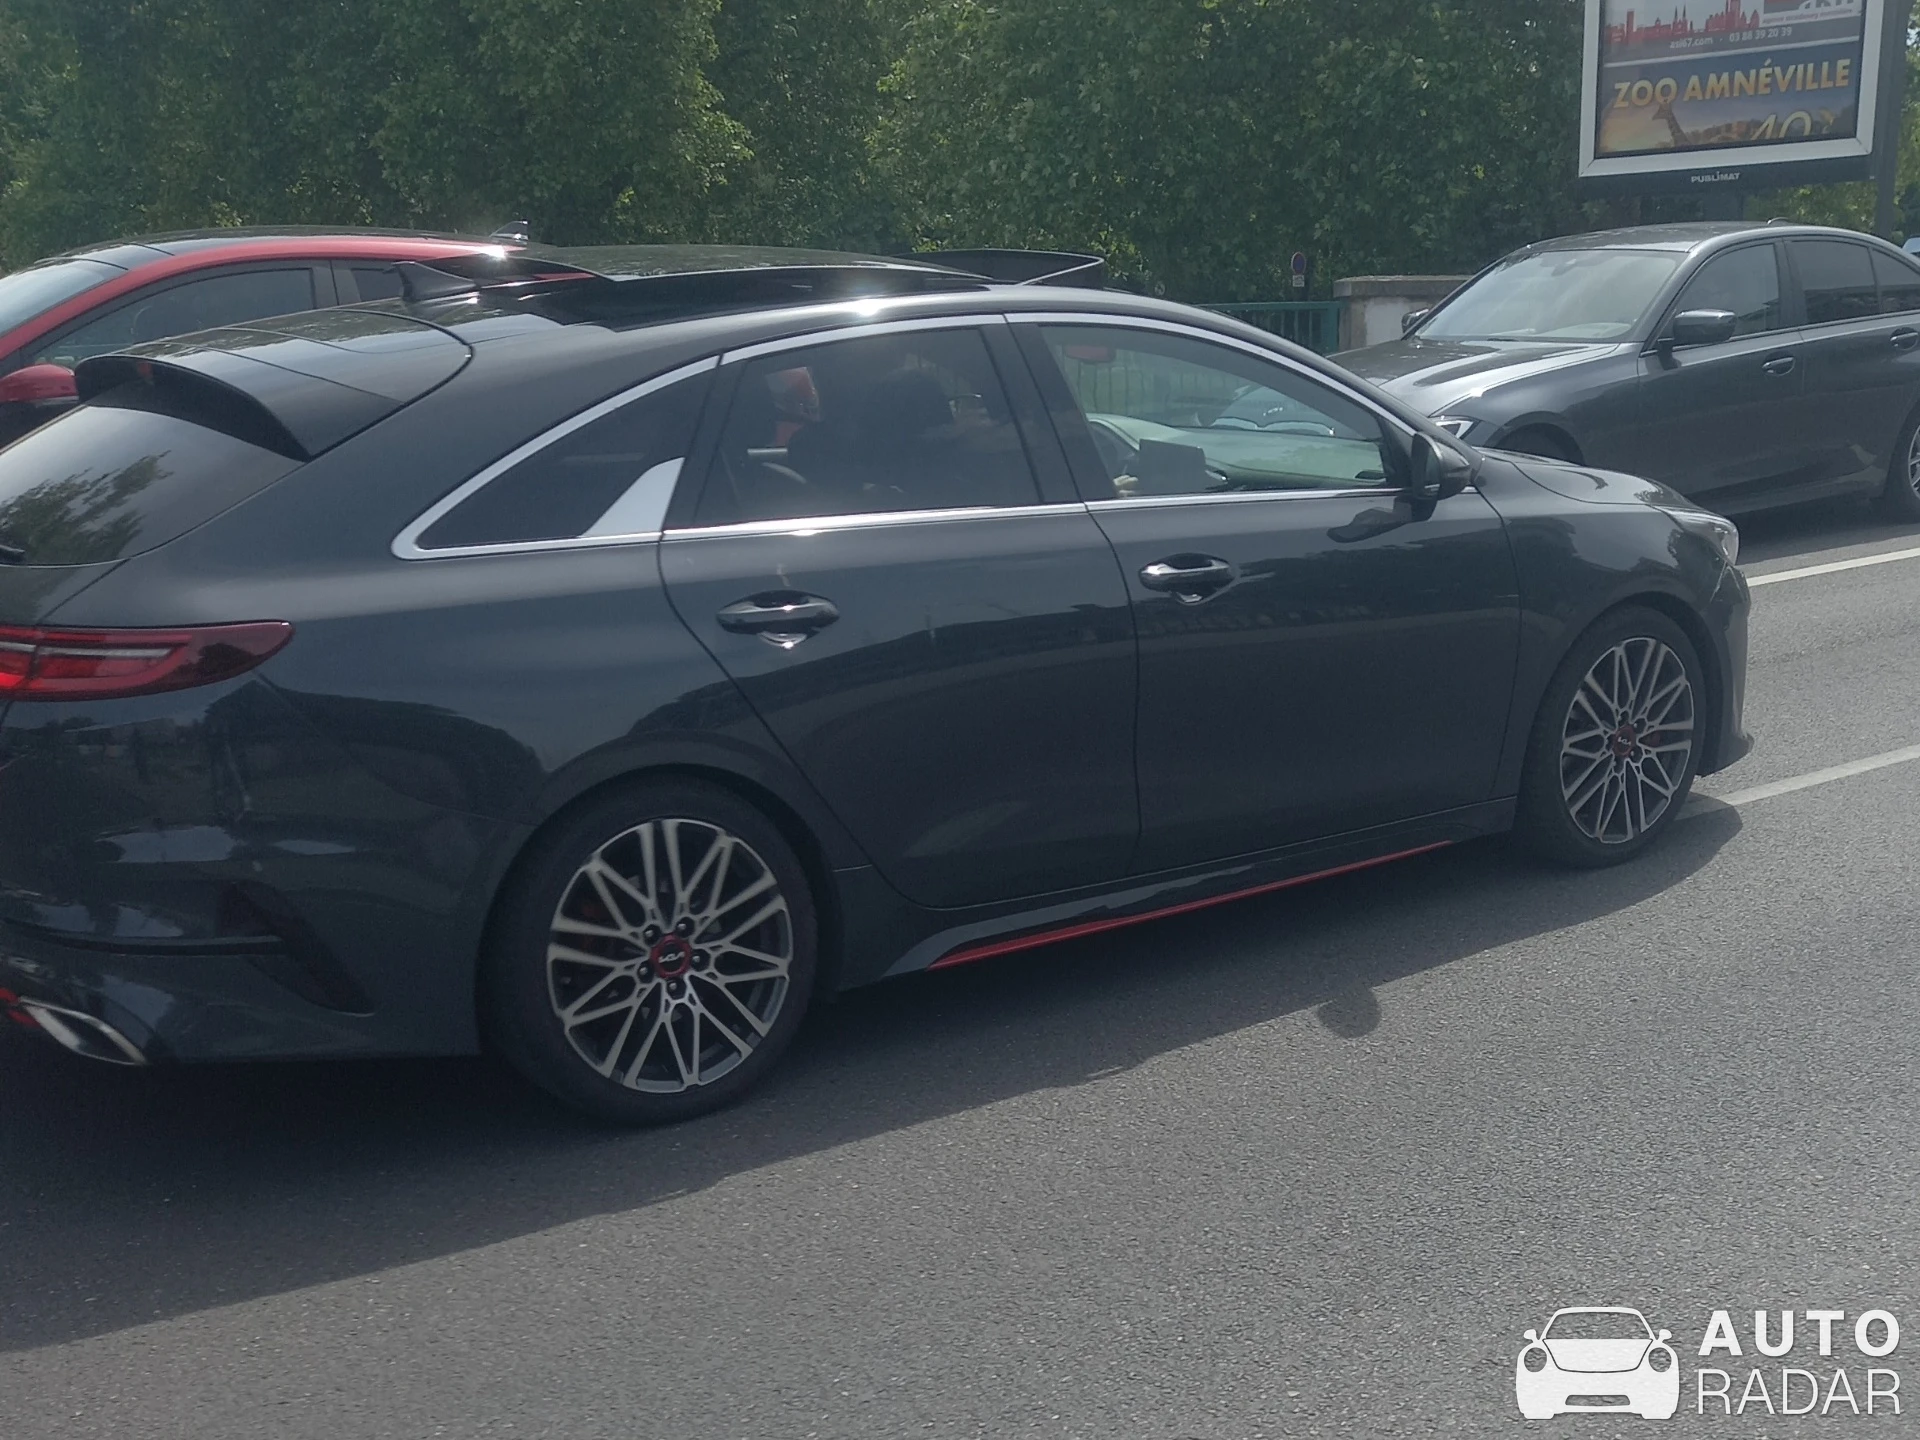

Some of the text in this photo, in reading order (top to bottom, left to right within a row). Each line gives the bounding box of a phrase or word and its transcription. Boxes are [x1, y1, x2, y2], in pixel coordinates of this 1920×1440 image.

[1729, 32, 1740, 43] 03
[1755, 29, 1766, 40] 39
[1768, 28, 1779, 38] 20
[1781, 26, 1793, 37] 39
[1613, 58, 1851, 108] ZOO AMNÉVILLE
